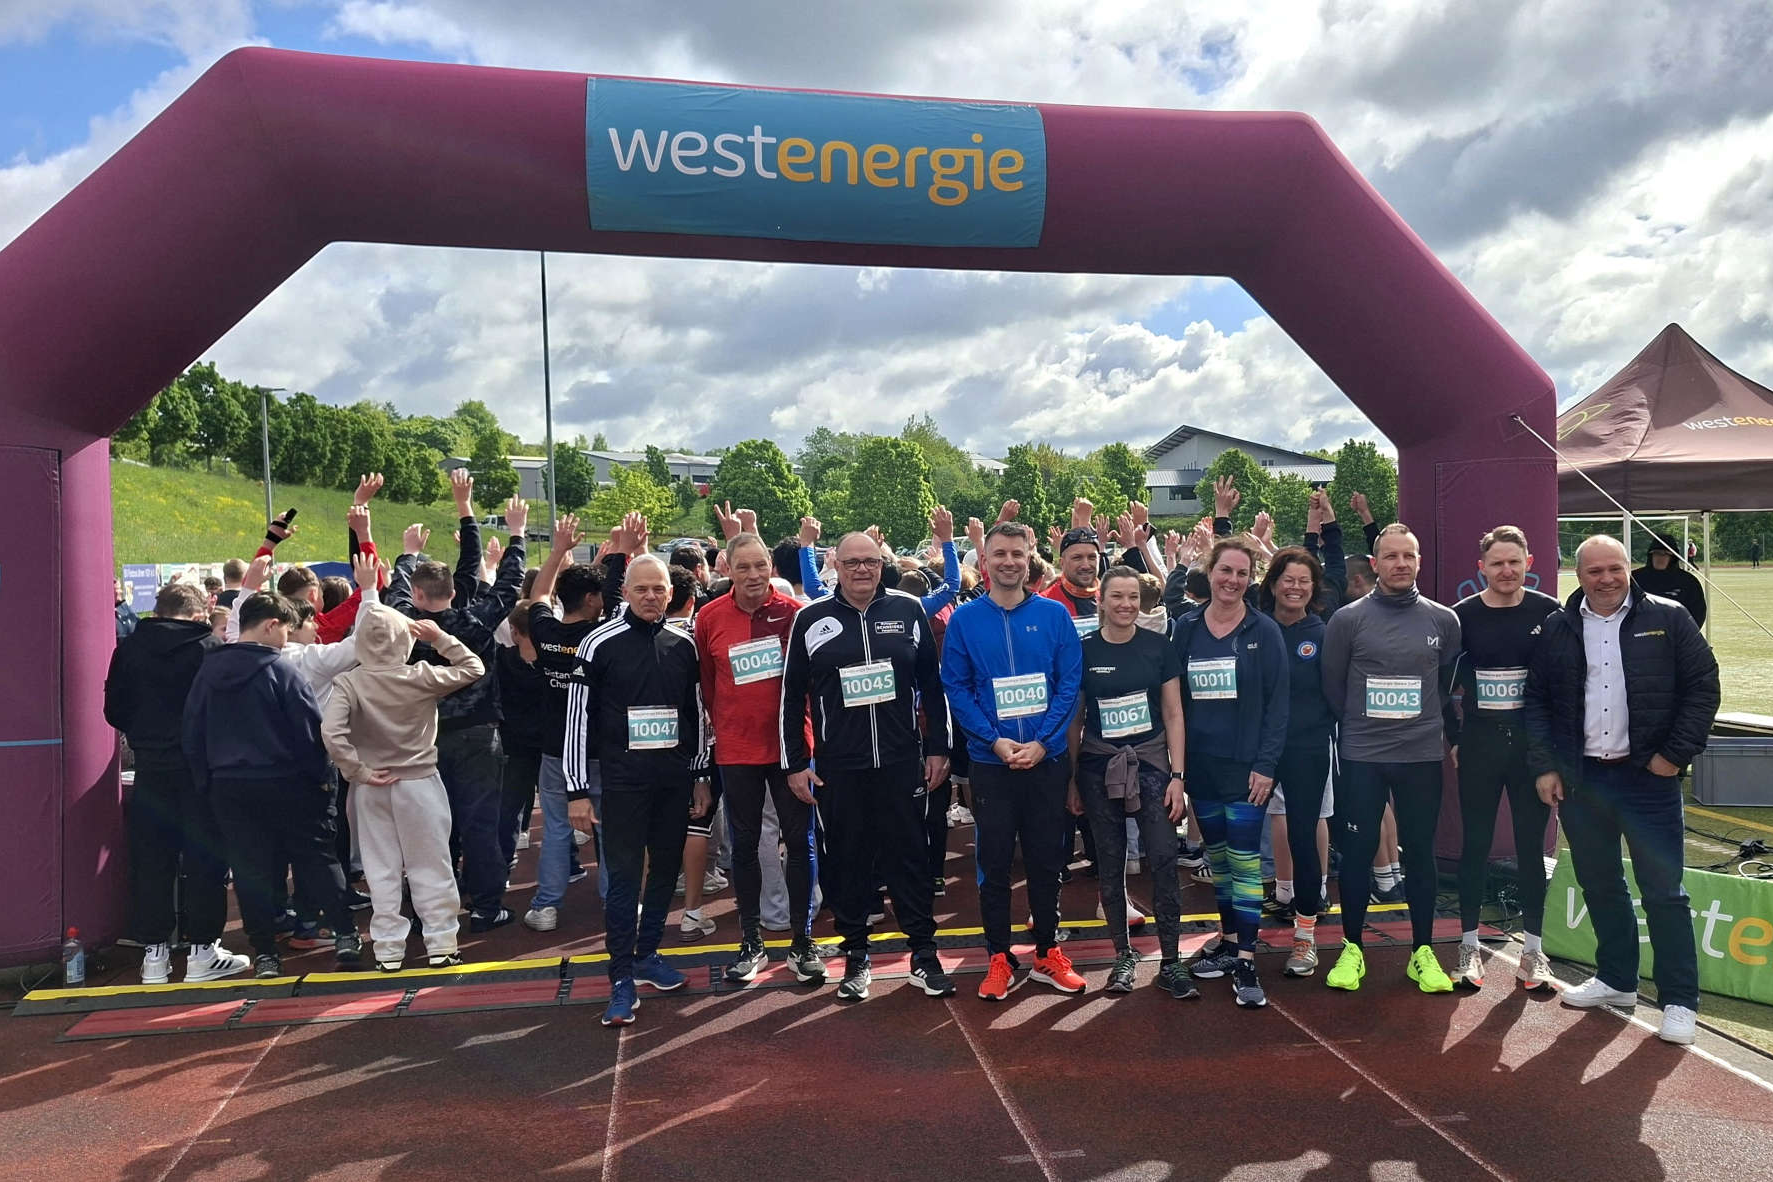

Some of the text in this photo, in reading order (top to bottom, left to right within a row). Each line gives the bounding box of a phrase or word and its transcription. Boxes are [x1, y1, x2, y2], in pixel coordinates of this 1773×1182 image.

[608, 124, 1025, 206] westenergie
[1682, 416, 1773, 430] westene
[732, 650, 783, 672] 10042
[843, 674, 893, 694] 10045
[1192, 672, 1231, 688] 10011
[996, 686, 1046, 704] 10040
[1368, 691, 1420, 706] 10043
[1102, 705, 1147, 725] 10067
[631, 721, 678, 737] 10047
